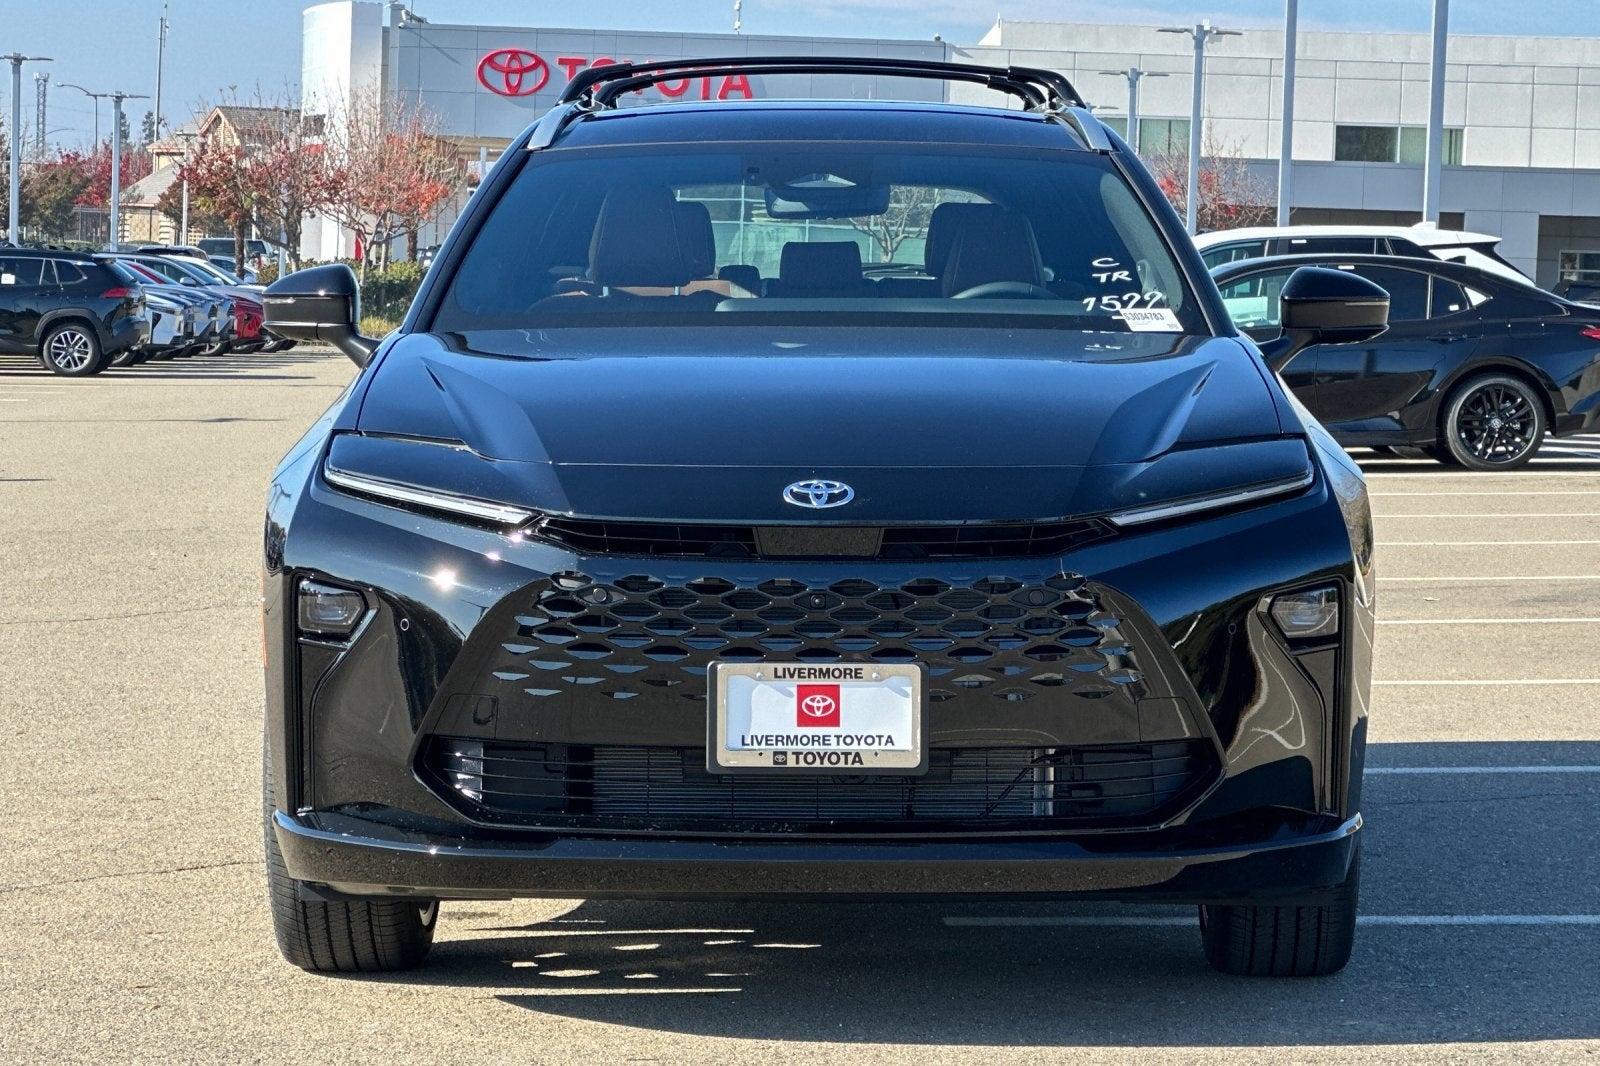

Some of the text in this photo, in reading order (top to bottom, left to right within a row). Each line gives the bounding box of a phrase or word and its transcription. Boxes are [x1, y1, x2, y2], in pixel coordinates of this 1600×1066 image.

[1092, 257, 1120, 267] C
[1092, 271, 1133, 283] TR
[773, 667, 864, 679] LIVERMORE
[741, 734, 895, 747] LIVERMORE TOYOTA
[791, 751, 864, 766] TOYOTA
